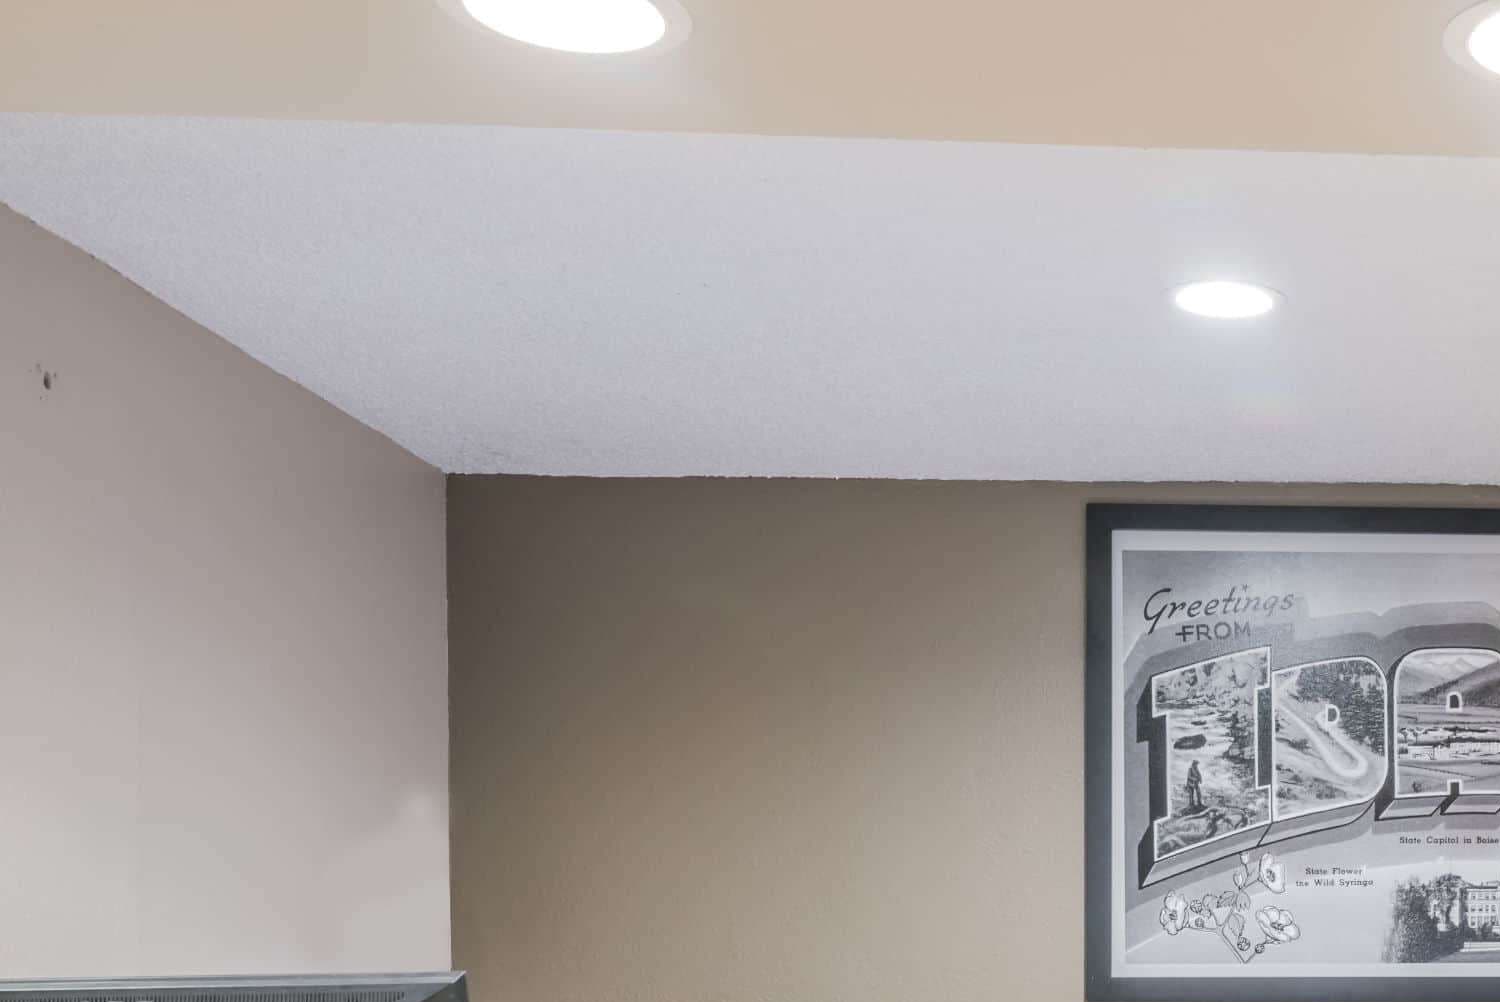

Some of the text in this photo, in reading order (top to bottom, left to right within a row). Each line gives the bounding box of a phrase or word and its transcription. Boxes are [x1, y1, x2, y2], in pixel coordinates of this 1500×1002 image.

[1143, 583, 1295, 636] Greetings
[1175, 621, 1251, 643] FROM
[1399, 836, 1500, 847] State Capitol in Boise
[1305, 866, 1363, 876] State Flower
[1313, 878, 1335, 887] Wild
